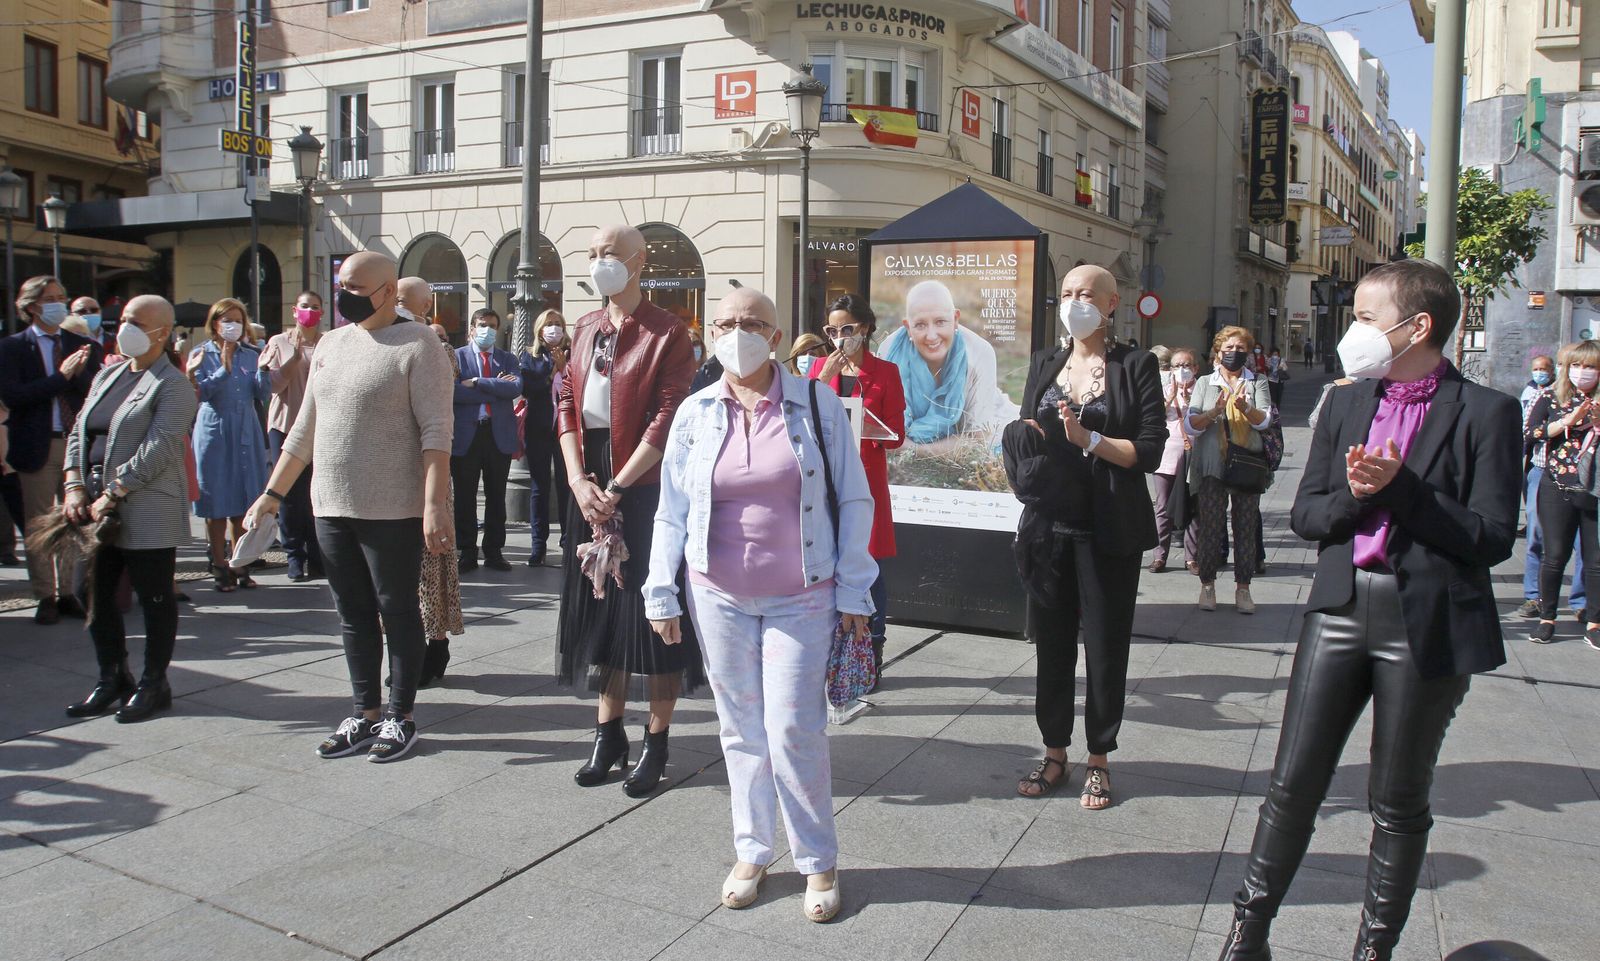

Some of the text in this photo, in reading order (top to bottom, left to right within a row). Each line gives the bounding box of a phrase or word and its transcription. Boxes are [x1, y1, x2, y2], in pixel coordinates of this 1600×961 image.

[825, 20, 928, 41] ABOGADOS
[209, 73, 277, 97] HOEL
[721, 75, 752, 110] LP
[223, 132, 273, 155] BOSON
[1258, 118, 1279, 201] EMFISA
[807, 241, 855, 252] ALVARO
[884, 268, 1017, 277] EXPOSICIÓN FOTOGRÁFICA GRAN FORMATO
[981, 288, 1017, 299] MUJERES
[988, 298, 1017, 309] QUE SE
[981, 308, 1017, 318] ATREVEN
